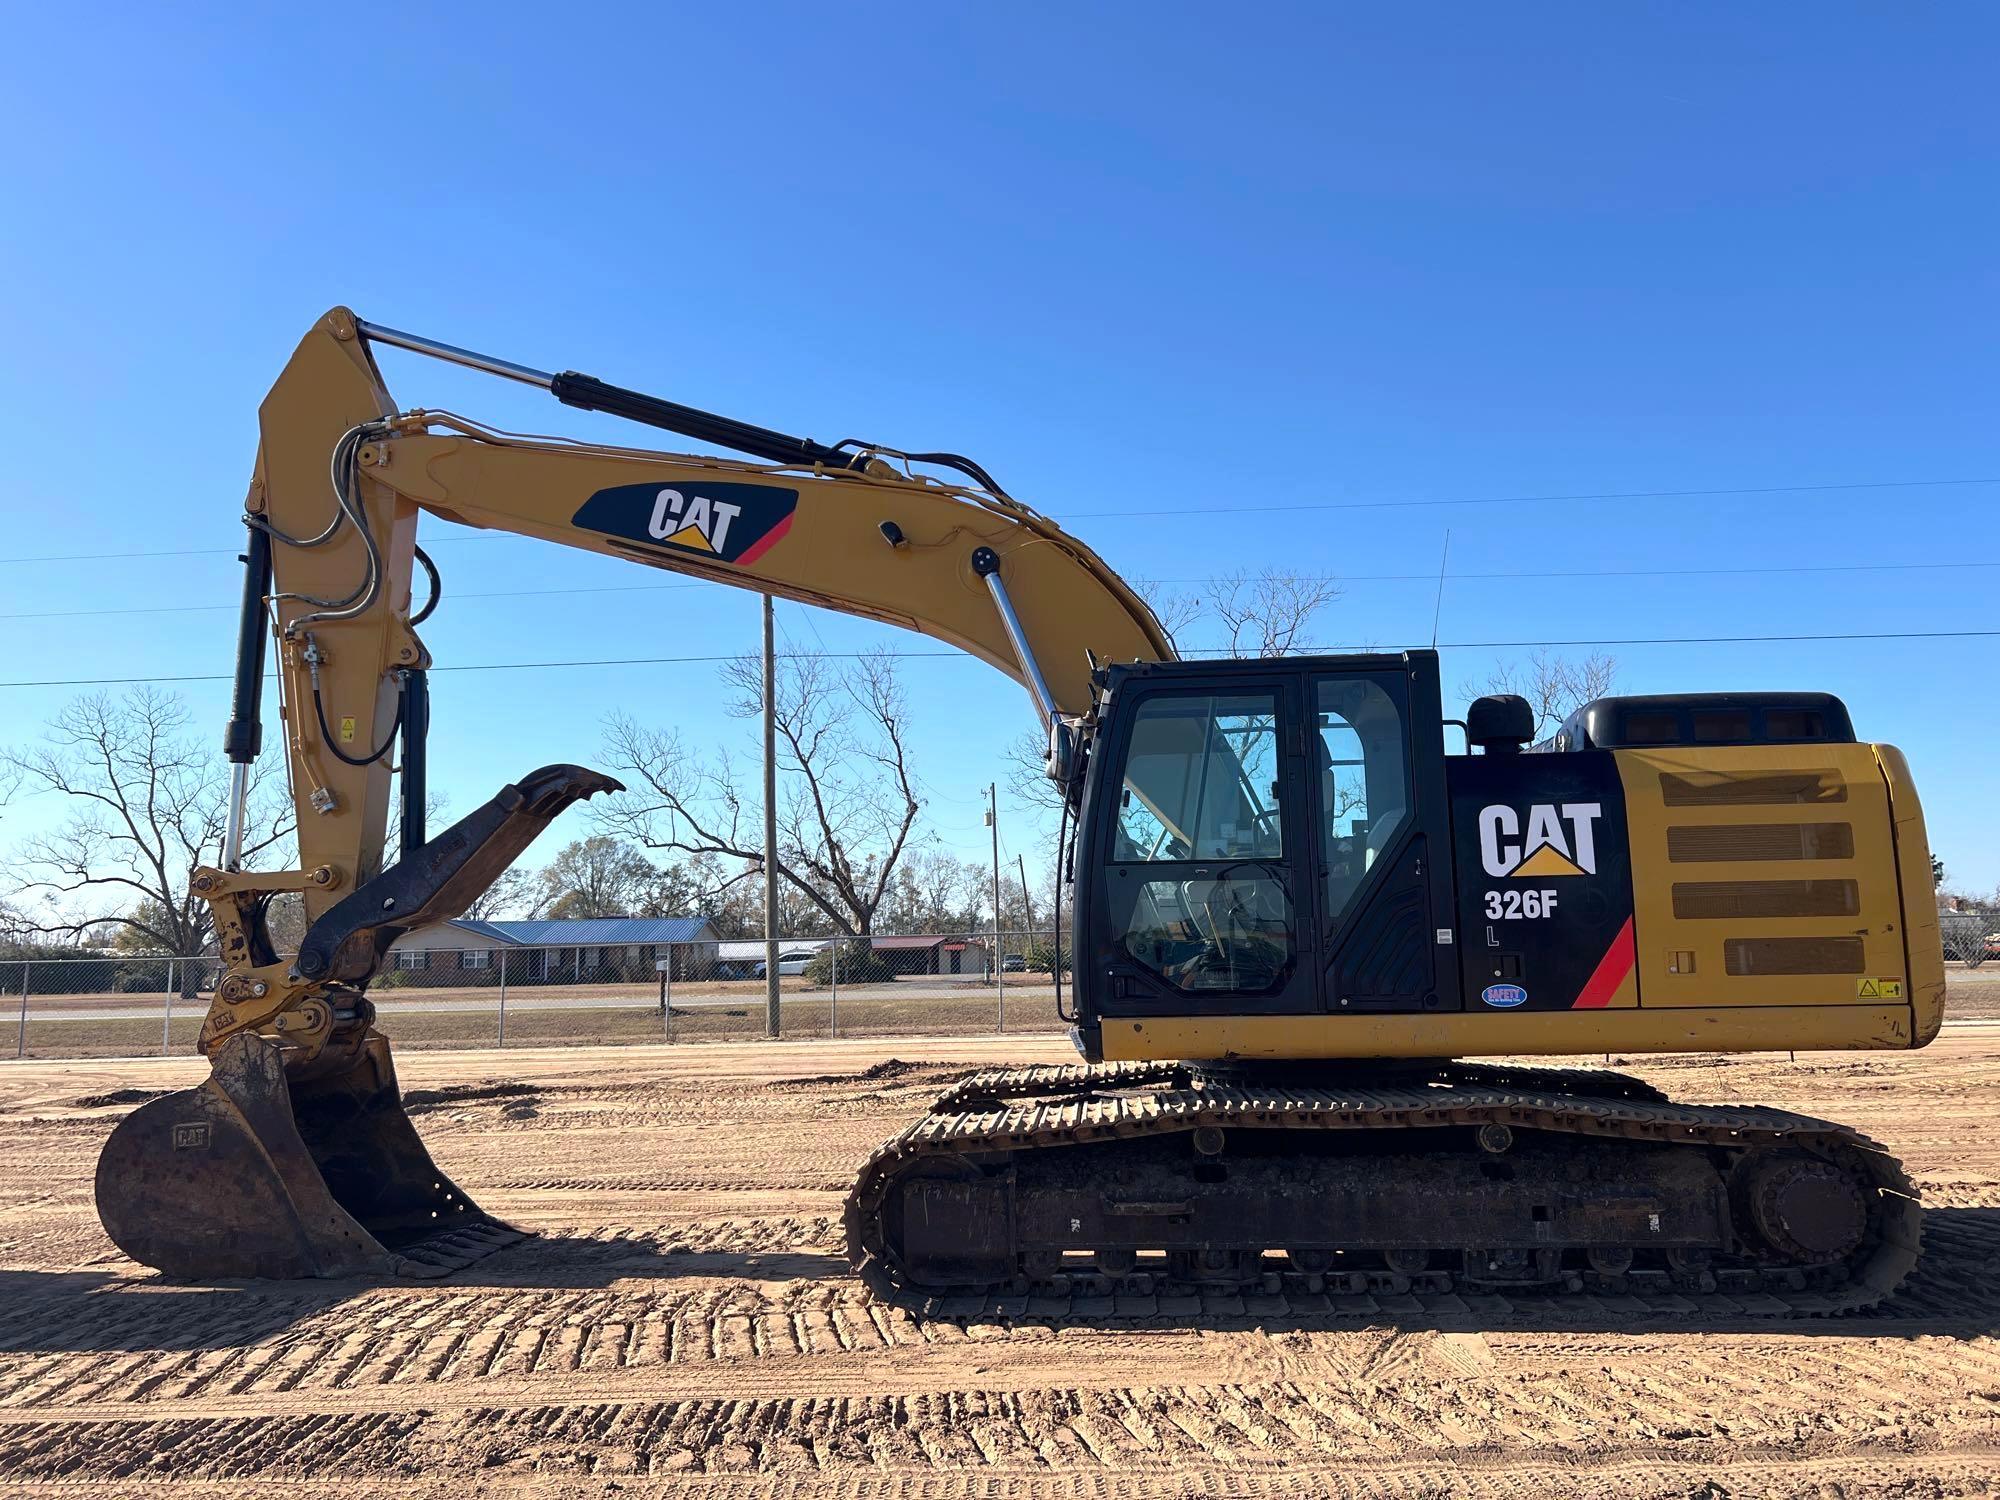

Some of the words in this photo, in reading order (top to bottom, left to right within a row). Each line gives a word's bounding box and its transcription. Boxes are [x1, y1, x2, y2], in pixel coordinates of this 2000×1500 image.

[648, 489, 741, 554] CAT
[1479, 802, 1601, 877] CAT
[1485, 889, 1557, 919] 326F
[1486, 925, 1499, 946] L
[1487, 988, 1521, 999] SAFETY
[177, 1128, 206, 1147] CAT
